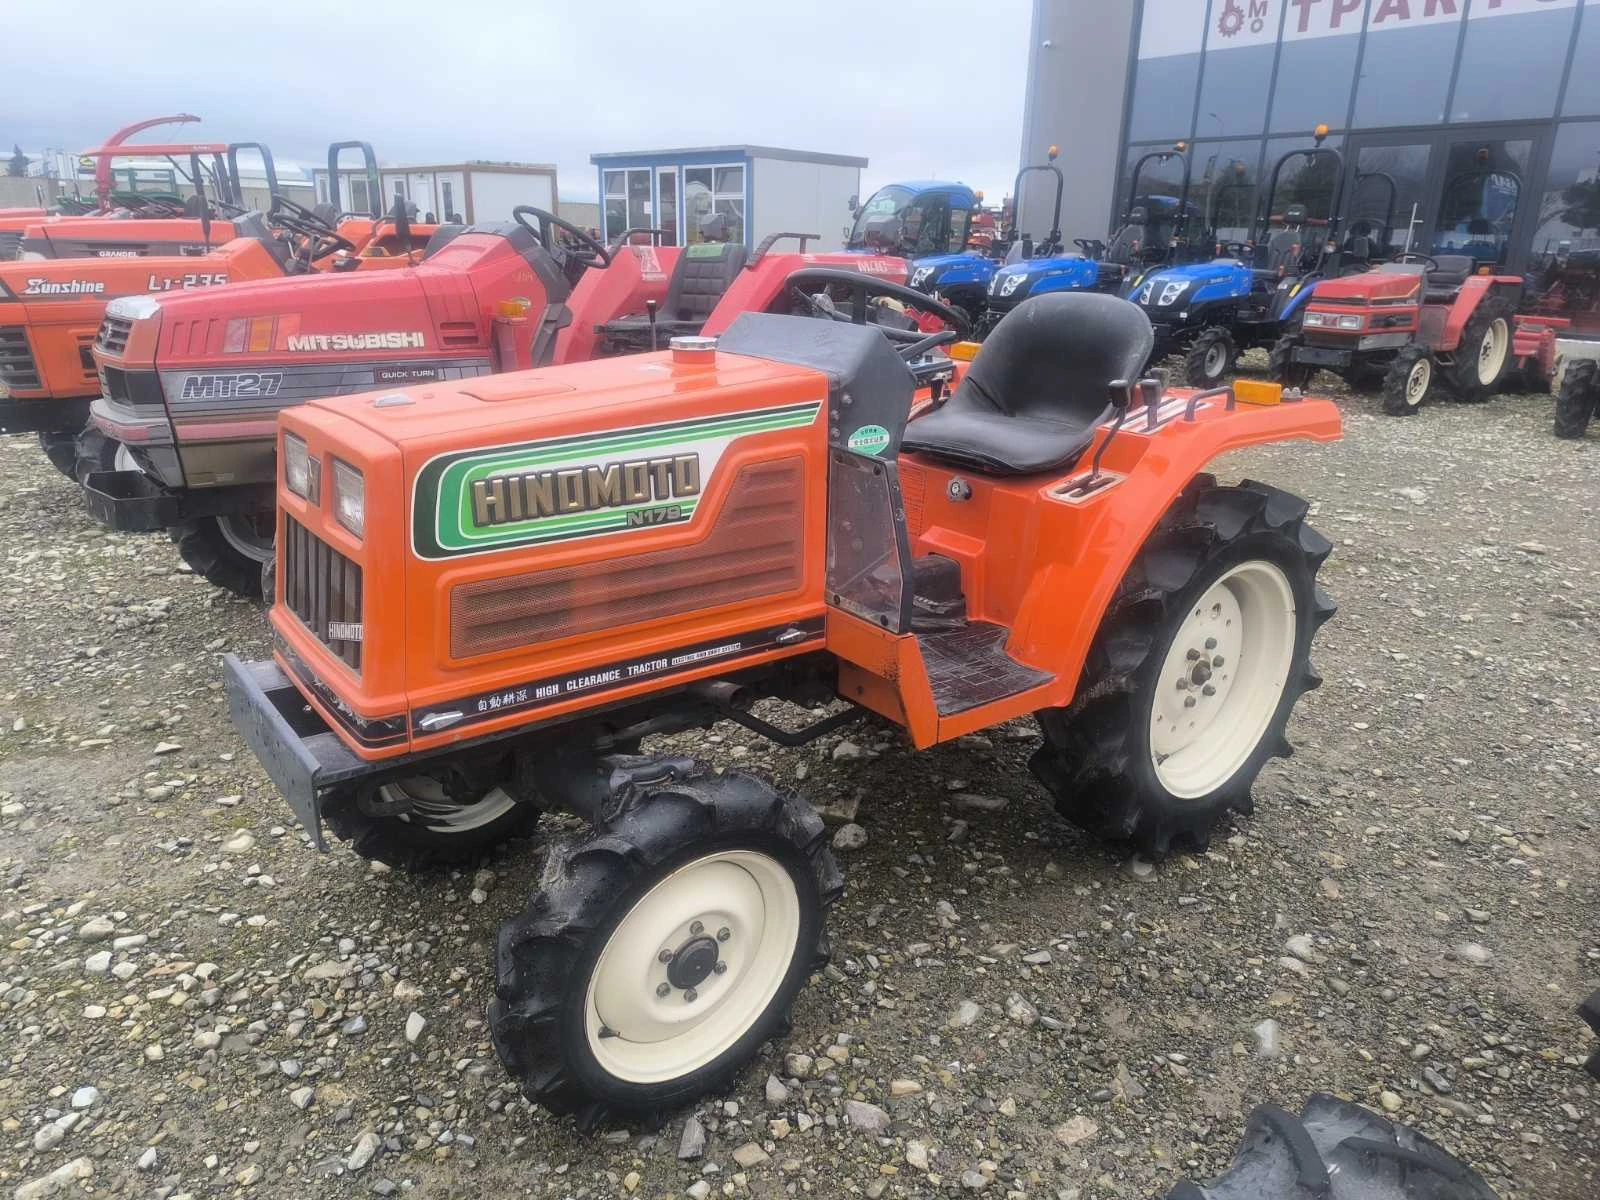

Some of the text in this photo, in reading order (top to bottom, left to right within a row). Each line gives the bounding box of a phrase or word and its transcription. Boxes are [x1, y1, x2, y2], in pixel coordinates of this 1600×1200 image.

[24, 278, 105, 294] Sunshine
[287, 332, 425, 351] MITSUBISHI
[180, 372, 283, 399] MT27
[381, 369, 435, 379] QUICK TURN
[472, 452, 700, 527] HINOMOTO
[535, 683, 560, 699] HIGH
[566, 669, 621, 691] CLEARANCE
[627, 658, 668, 677] TRACTOR
